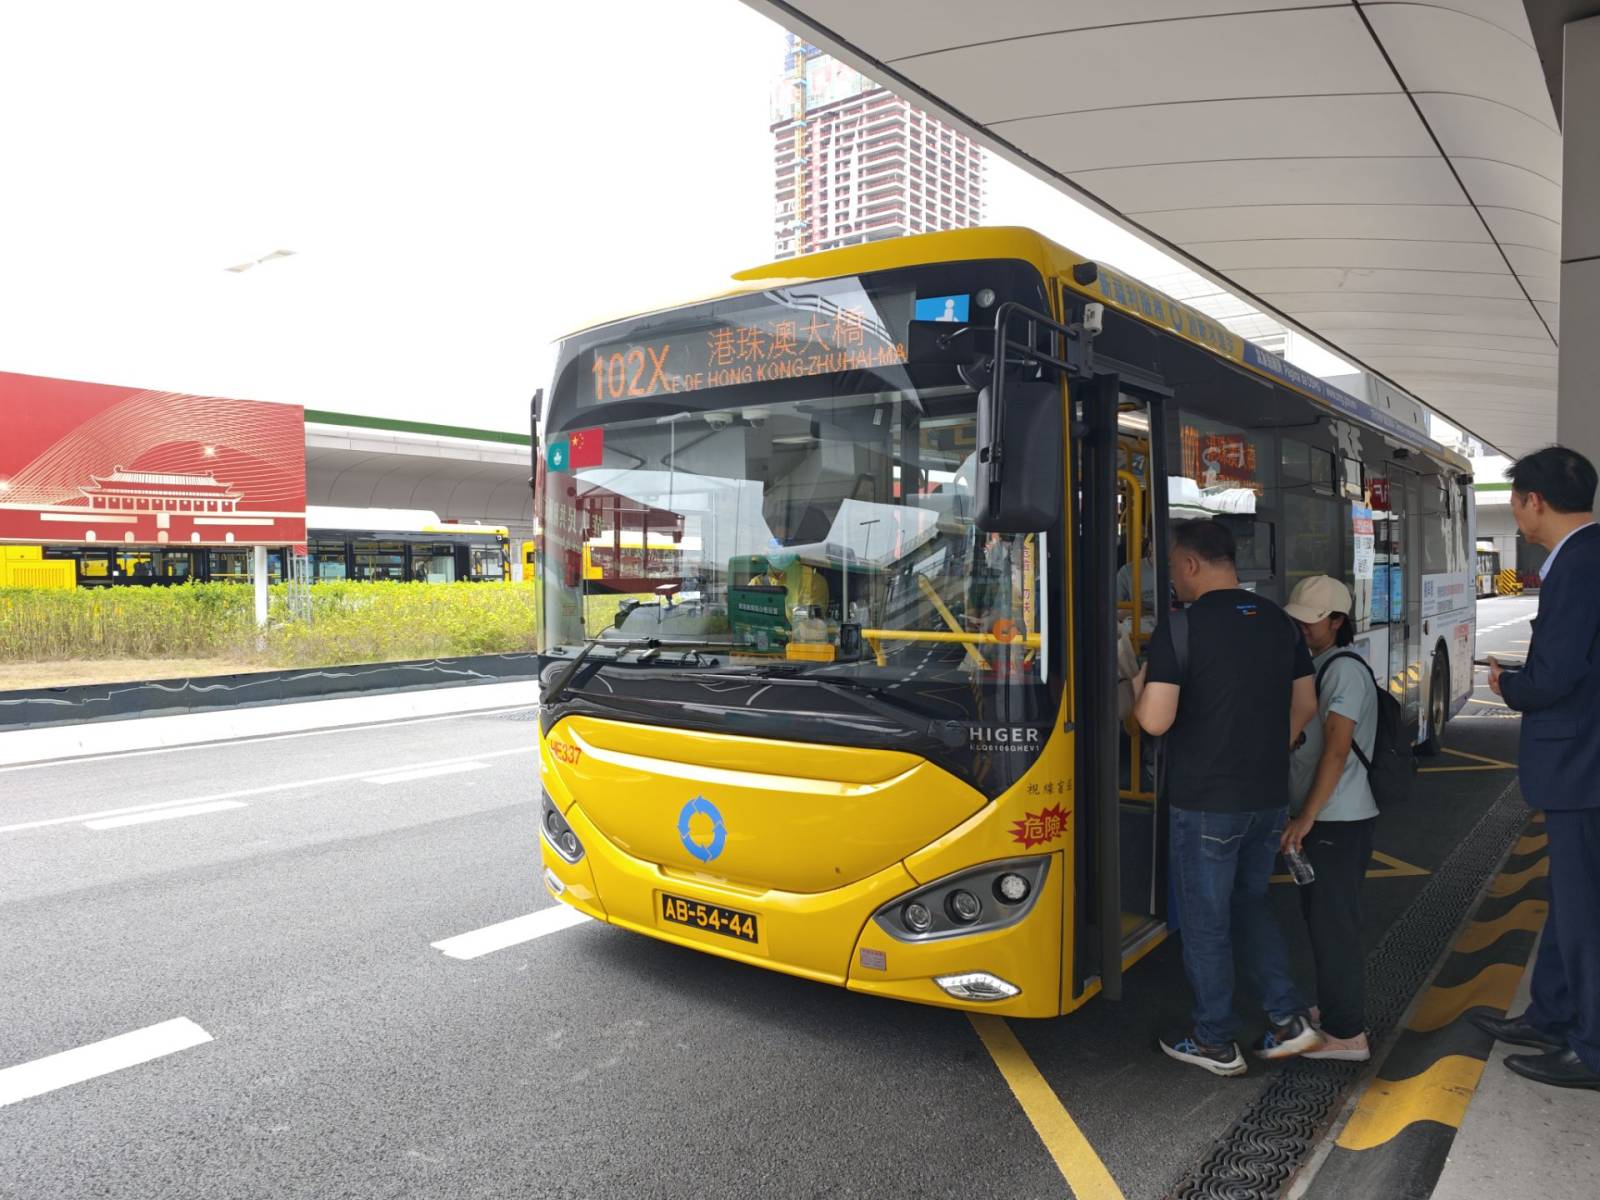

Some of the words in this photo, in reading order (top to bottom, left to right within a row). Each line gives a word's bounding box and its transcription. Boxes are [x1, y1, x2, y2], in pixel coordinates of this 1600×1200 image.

[707, 306, 864, 366] 港珠澳大橋
[592, 344, 669, 400] 102X
[708, 366, 752, 388] HONG
[969, 727, 1039, 742] HIGER
[1024, 816, 1061, 839] 危險
[666, 898, 754, 939] AB-54-44
